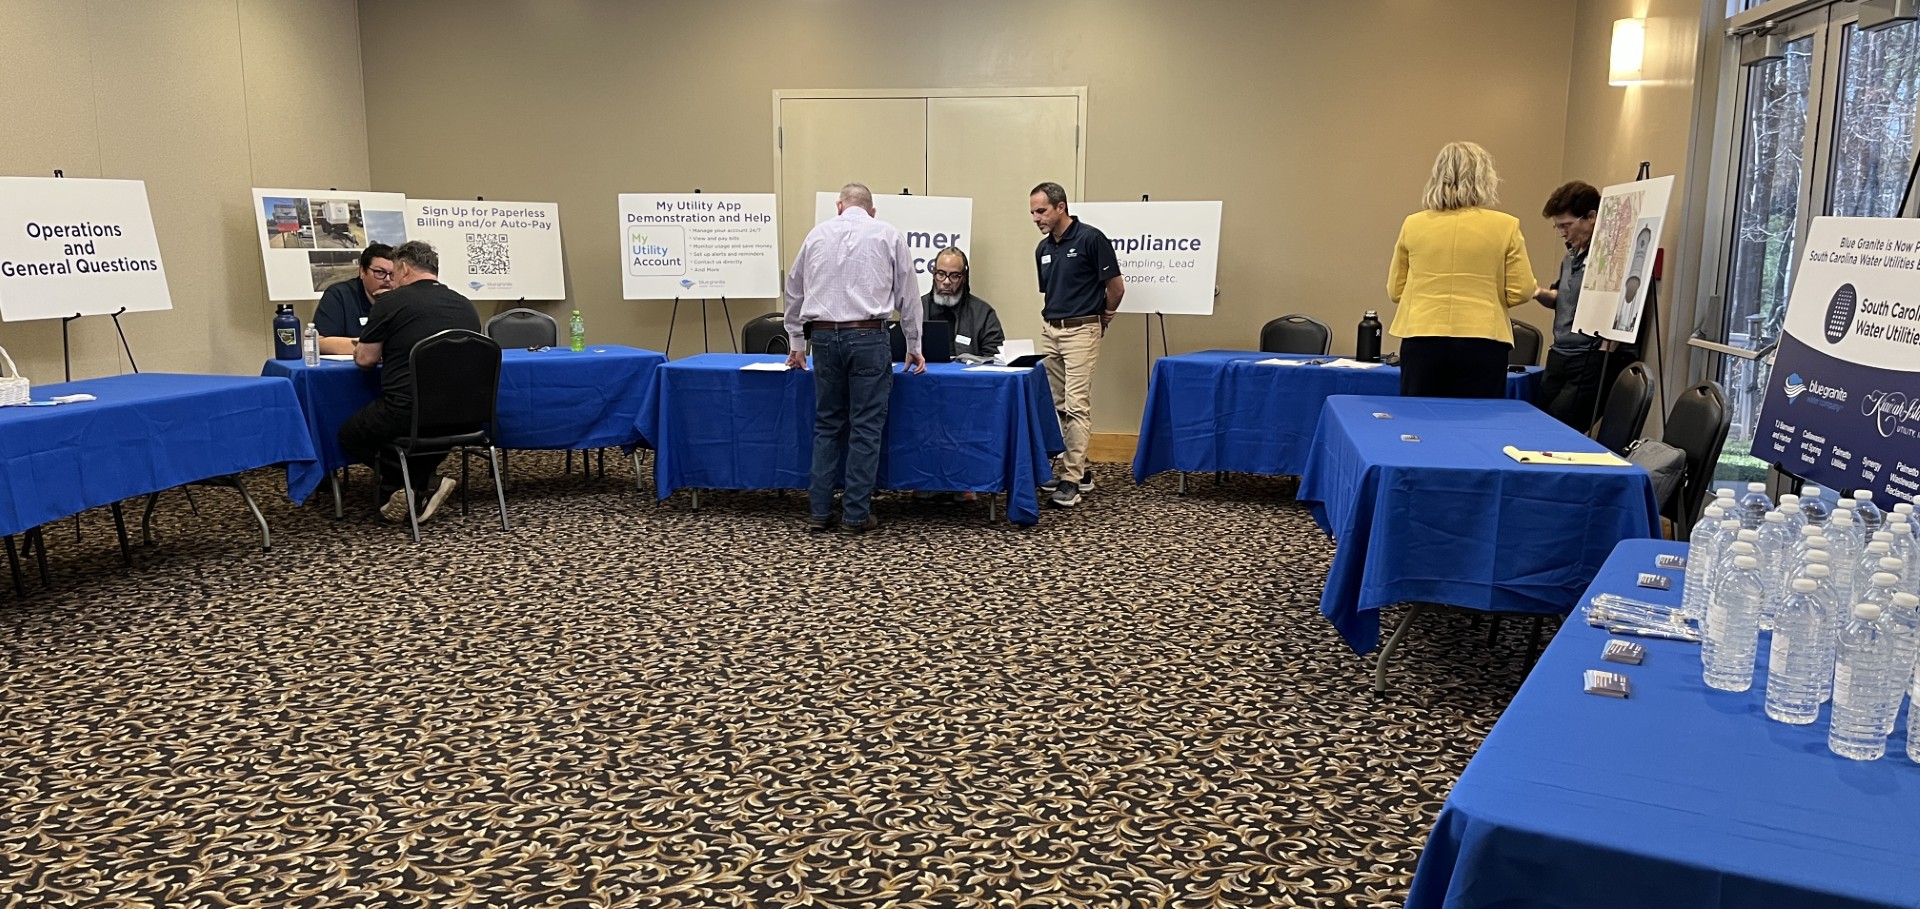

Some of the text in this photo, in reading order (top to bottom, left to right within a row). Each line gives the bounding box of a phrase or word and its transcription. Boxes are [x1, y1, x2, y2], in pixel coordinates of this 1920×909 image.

[422, 206, 545, 218] Sign Up for Paperless
[657, 201, 741, 212] My Utility App
[417, 218, 551, 230] Billing and/or Auto-Pay
[628, 213, 771, 223] Demonstration and Help
[26, 222, 122, 240] Operations
[632, 234, 648, 244] My
[907, 232, 960, 248] mer
[1111, 234, 1201, 254] mpliance
[1840, 237, 1855, 249] Blue
[1858, 238, 1884, 251] Granite
[1886, 239, 1892, 251] is
[1894, 240, 1913, 253] Now
[64, 240, 95, 255] and
[633, 245, 668, 257] Utility
[2, 257, 157, 276] General Questions
[634, 257, 681, 266] Account
[1169, 259, 1194, 268] Lead
[1809, 250, 1828, 262] South
[1829, 252, 1858, 265] Carolina
[1860, 254, 1882, 266] Water
[1883, 256, 1914, 269] Utilities
[1123, 274, 1178, 283] opper, etc.
[1861, 299, 1889, 316] South
[1856, 320, 1920, 346] Water Utilitie
[1809, 380, 1847, 401] bluegranite
[1808, 443, 1822, 456] Spring
[1832, 446, 1851, 459] Palmetto
[1831, 458, 1847, 470] Utilities
[1862, 457, 1882, 472] Synergy
[1896, 461, 1919, 477] Palmetto
[1862, 469, 1876, 482] Utility
[1890, 473, 1920, 490] Wastewater
[1885, 484, 1913, 502] Reclamatio
